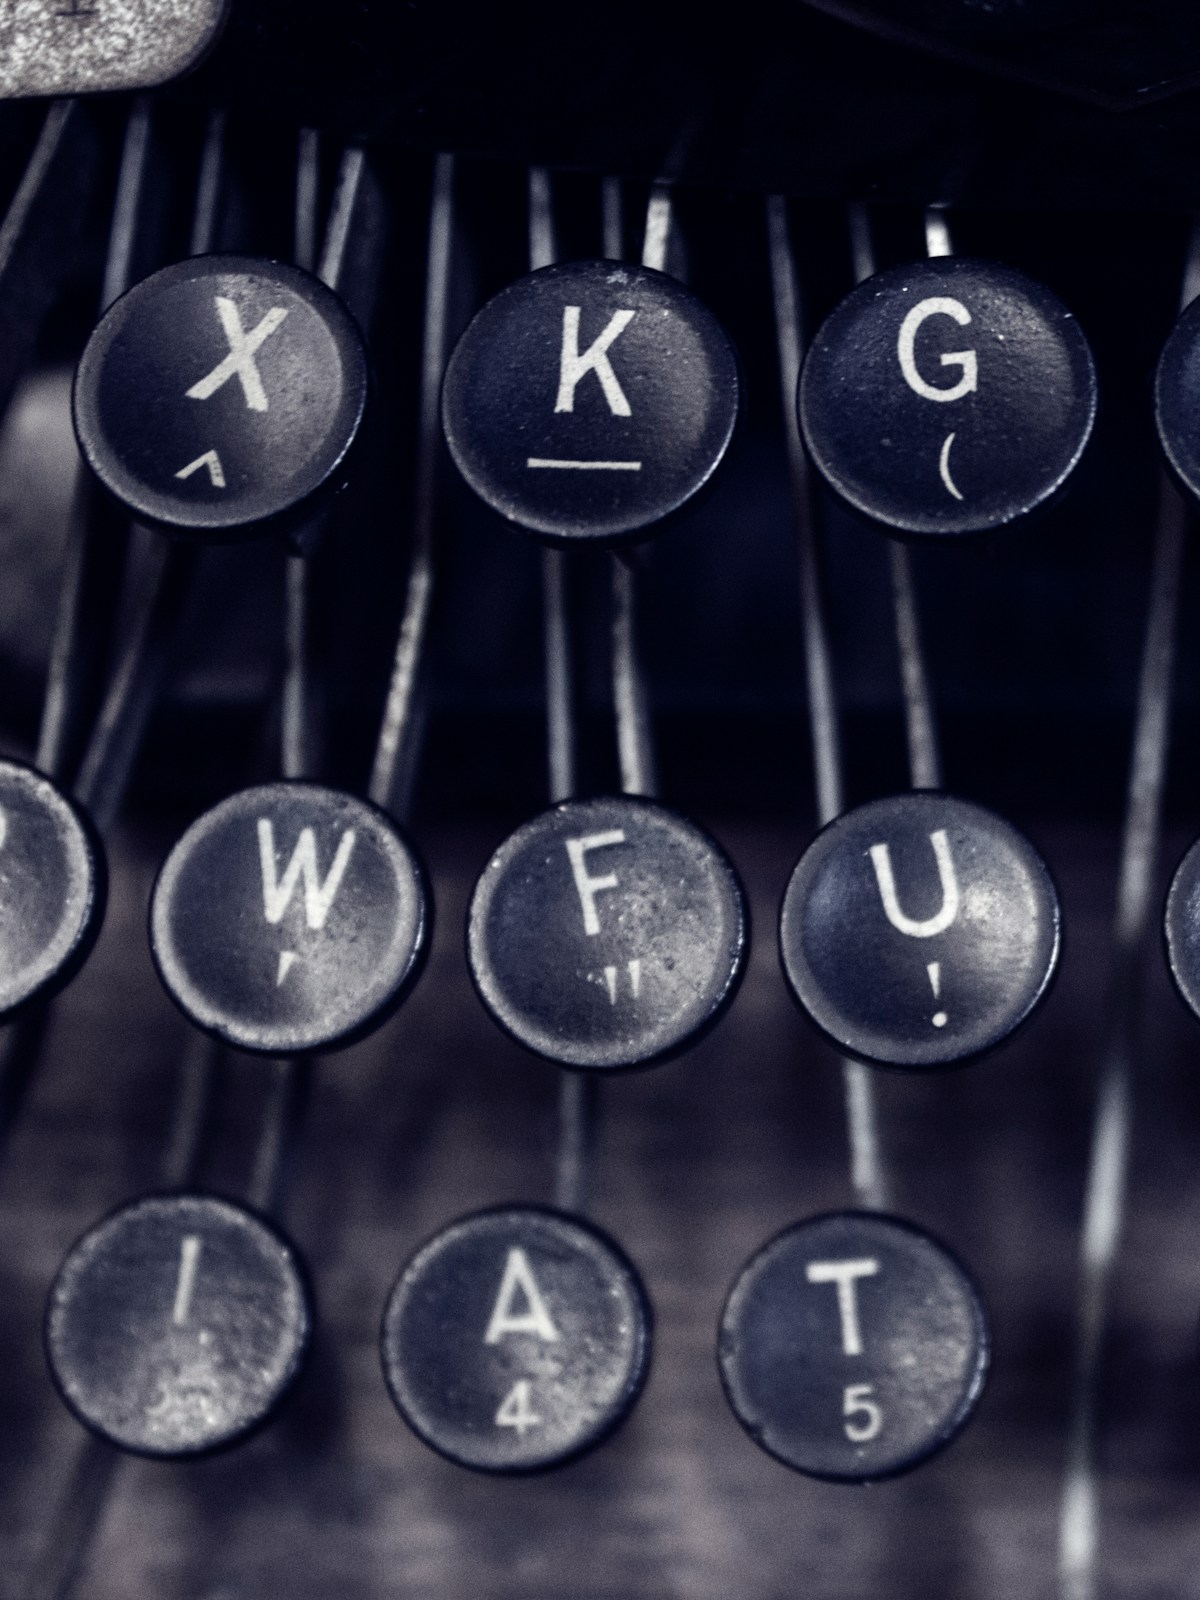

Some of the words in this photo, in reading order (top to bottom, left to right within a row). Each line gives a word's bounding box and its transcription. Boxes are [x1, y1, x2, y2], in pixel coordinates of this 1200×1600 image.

[186, 297, 289, 412] X
[555, 306, 636, 416] K
[898, 297, 977, 401] G
[940, 433, 962, 499] (
[258, 818, 355, 929] W
[565, 830, 625, 936] F
[869, 830, 959, 937] U
[927, 962, 947, 1026] !
[485, 1247, 559, 1345] A
[807, 1259, 877, 1355] T
[494, 1380, 540, 1433] 4
[844, 1385, 882, 1441] 5
